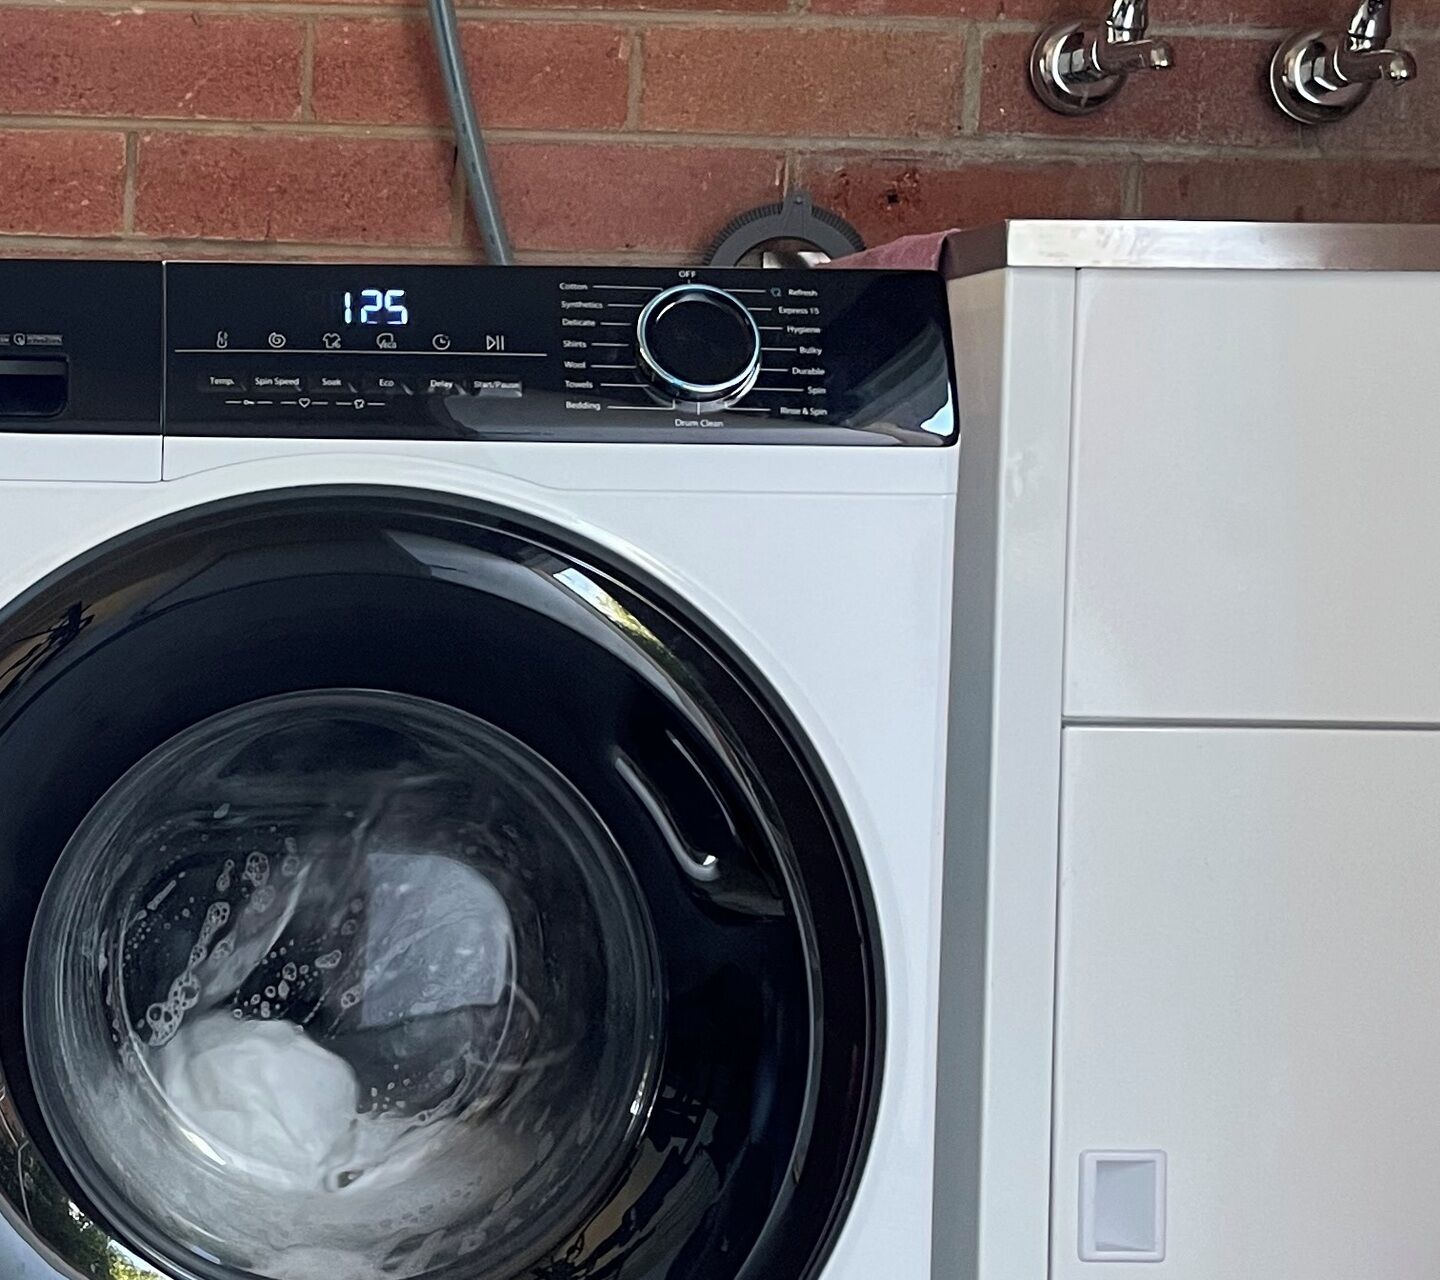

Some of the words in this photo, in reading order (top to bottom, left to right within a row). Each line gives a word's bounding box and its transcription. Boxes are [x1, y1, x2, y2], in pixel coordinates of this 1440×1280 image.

[559, 282, 588, 290] Cotton
[788, 289, 818, 297] Refresh
[344, 289, 408, 325] 125
[561, 300, 603, 309] Synthetics
[778, 306, 808, 315] Express
[561, 318, 596, 327] Delicate
[786, 326, 821, 335] Hygiene
[563, 340, 587, 348] Shirts
[799, 346, 822, 356] Bulky
[564, 361, 586, 369] Wool
[792, 367, 826, 375] Durable
[254, 377, 273, 386] Spin
[274, 377, 300, 386] Speed
[322, 378, 342, 386] Soak
[379, 378, 394, 387] Eco
[430, 379, 453, 389] Delay
[564, 380, 593, 389] Towels
[807, 386, 827, 395] Spin
[565, 401, 601, 411] Bedding
[780, 407, 800, 415] Rinse
[809, 408, 828, 416] Spin
[675, 419, 698, 427] Drum
[700, 420, 724, 428] Clean
